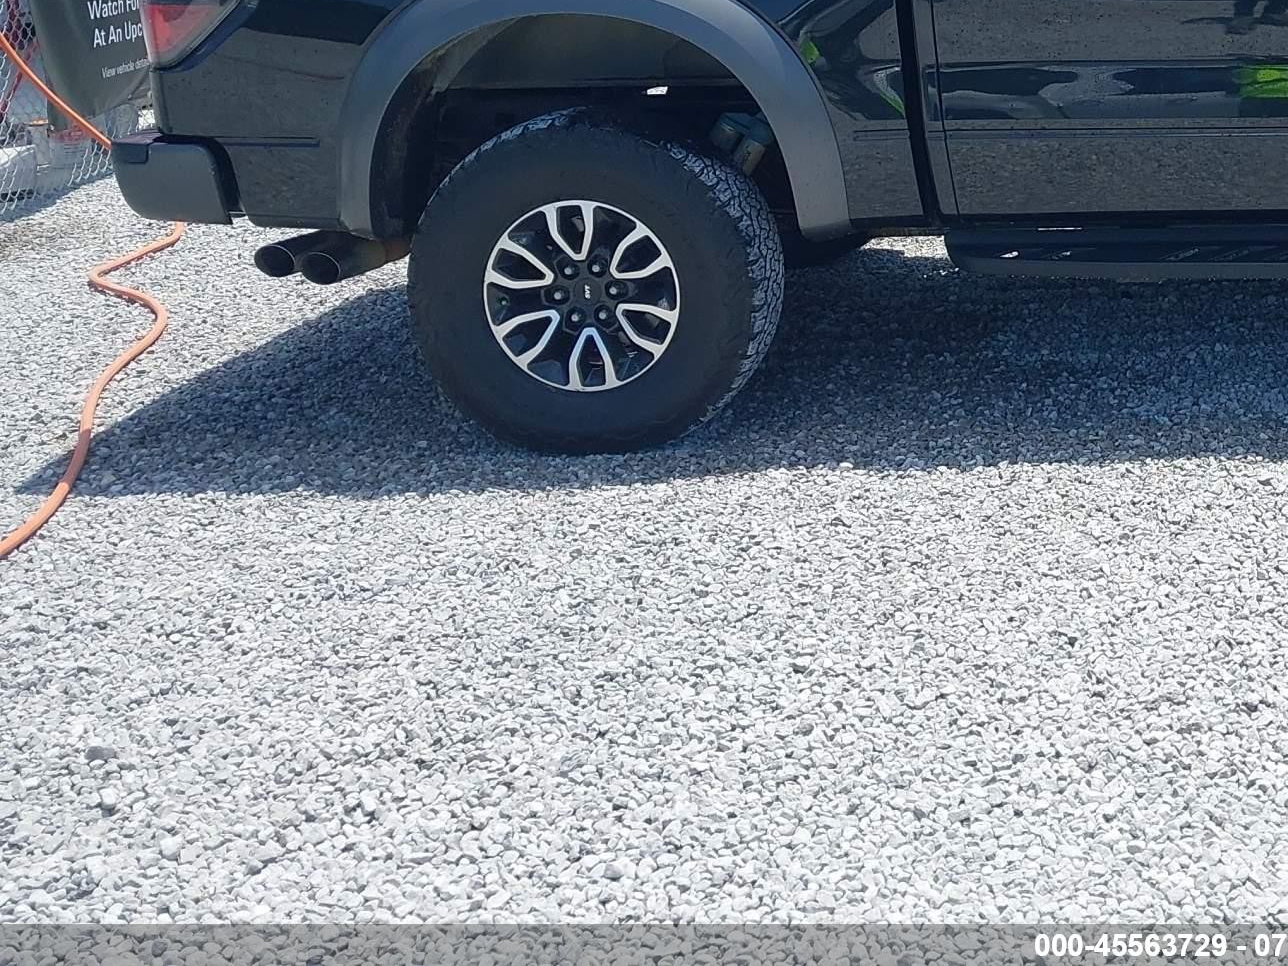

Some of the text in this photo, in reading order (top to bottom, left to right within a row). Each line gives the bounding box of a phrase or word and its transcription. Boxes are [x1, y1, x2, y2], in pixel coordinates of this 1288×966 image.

[93, 20, 143, 48] At An Upc
[101, 66, 116, 79] View
